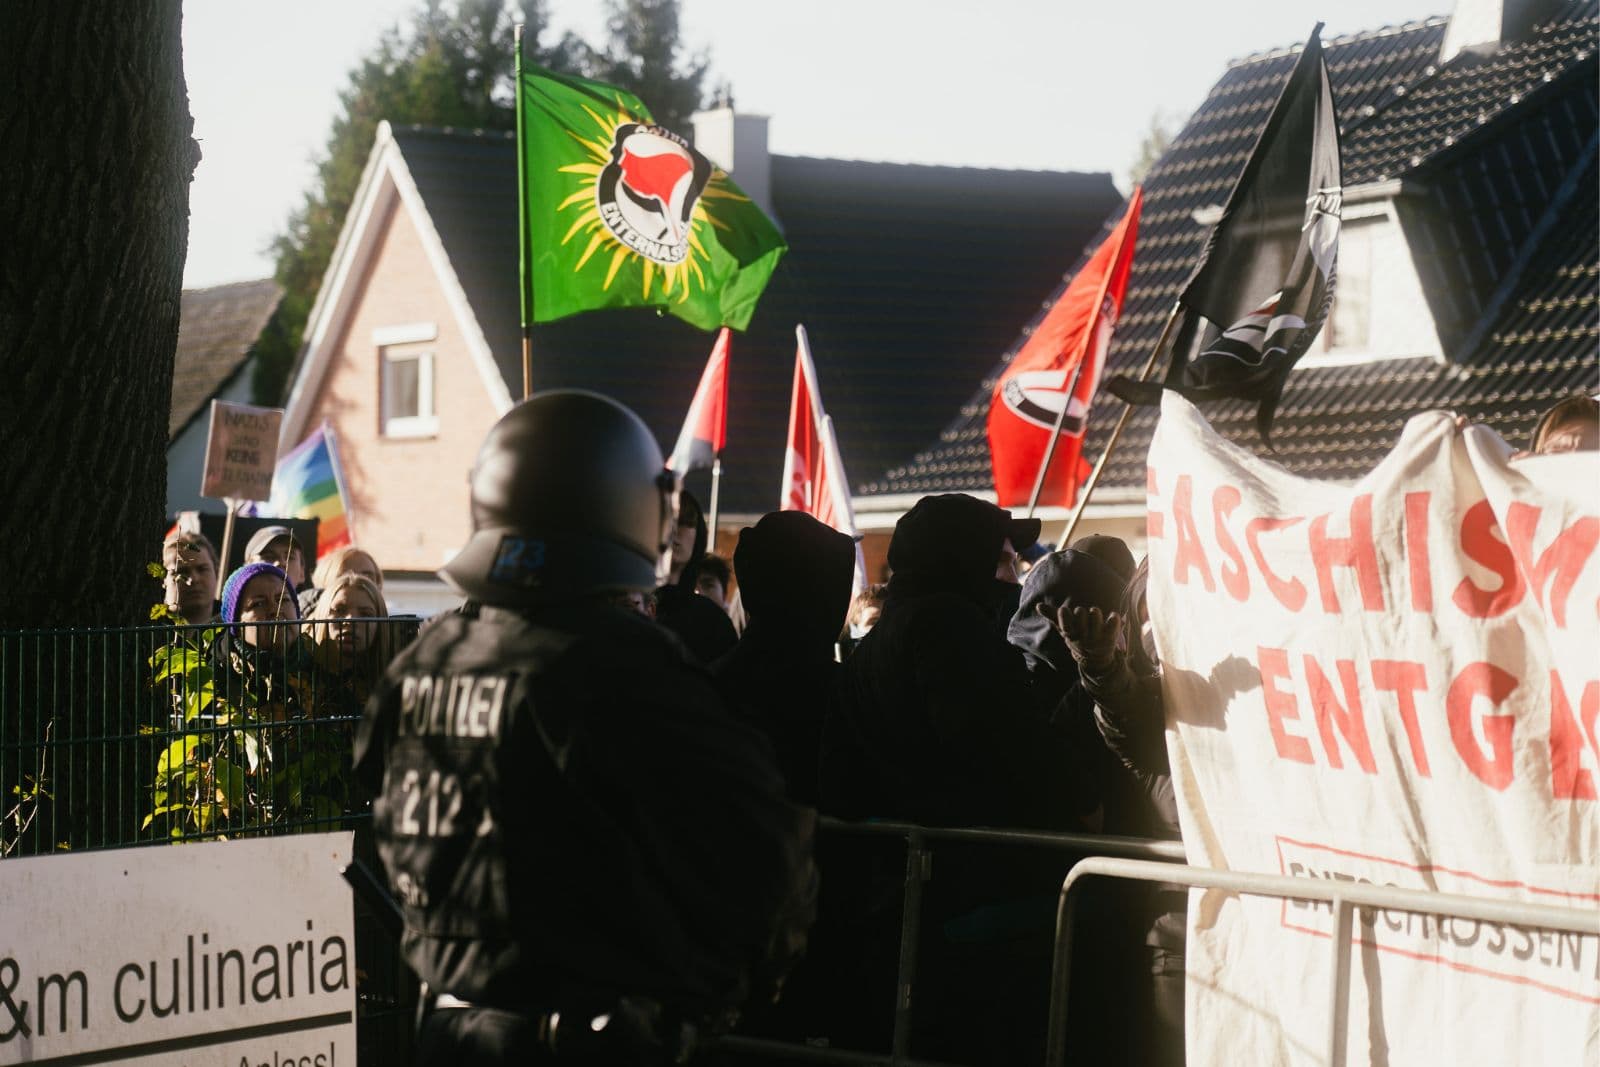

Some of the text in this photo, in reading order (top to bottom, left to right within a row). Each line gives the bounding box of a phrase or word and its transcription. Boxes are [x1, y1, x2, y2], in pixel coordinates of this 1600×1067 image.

[1147, 466, 1600, 630] ASCHISM
[398, 675, 508, 738] POLIZEI
[113, 920, 349, 1024] culinaria
